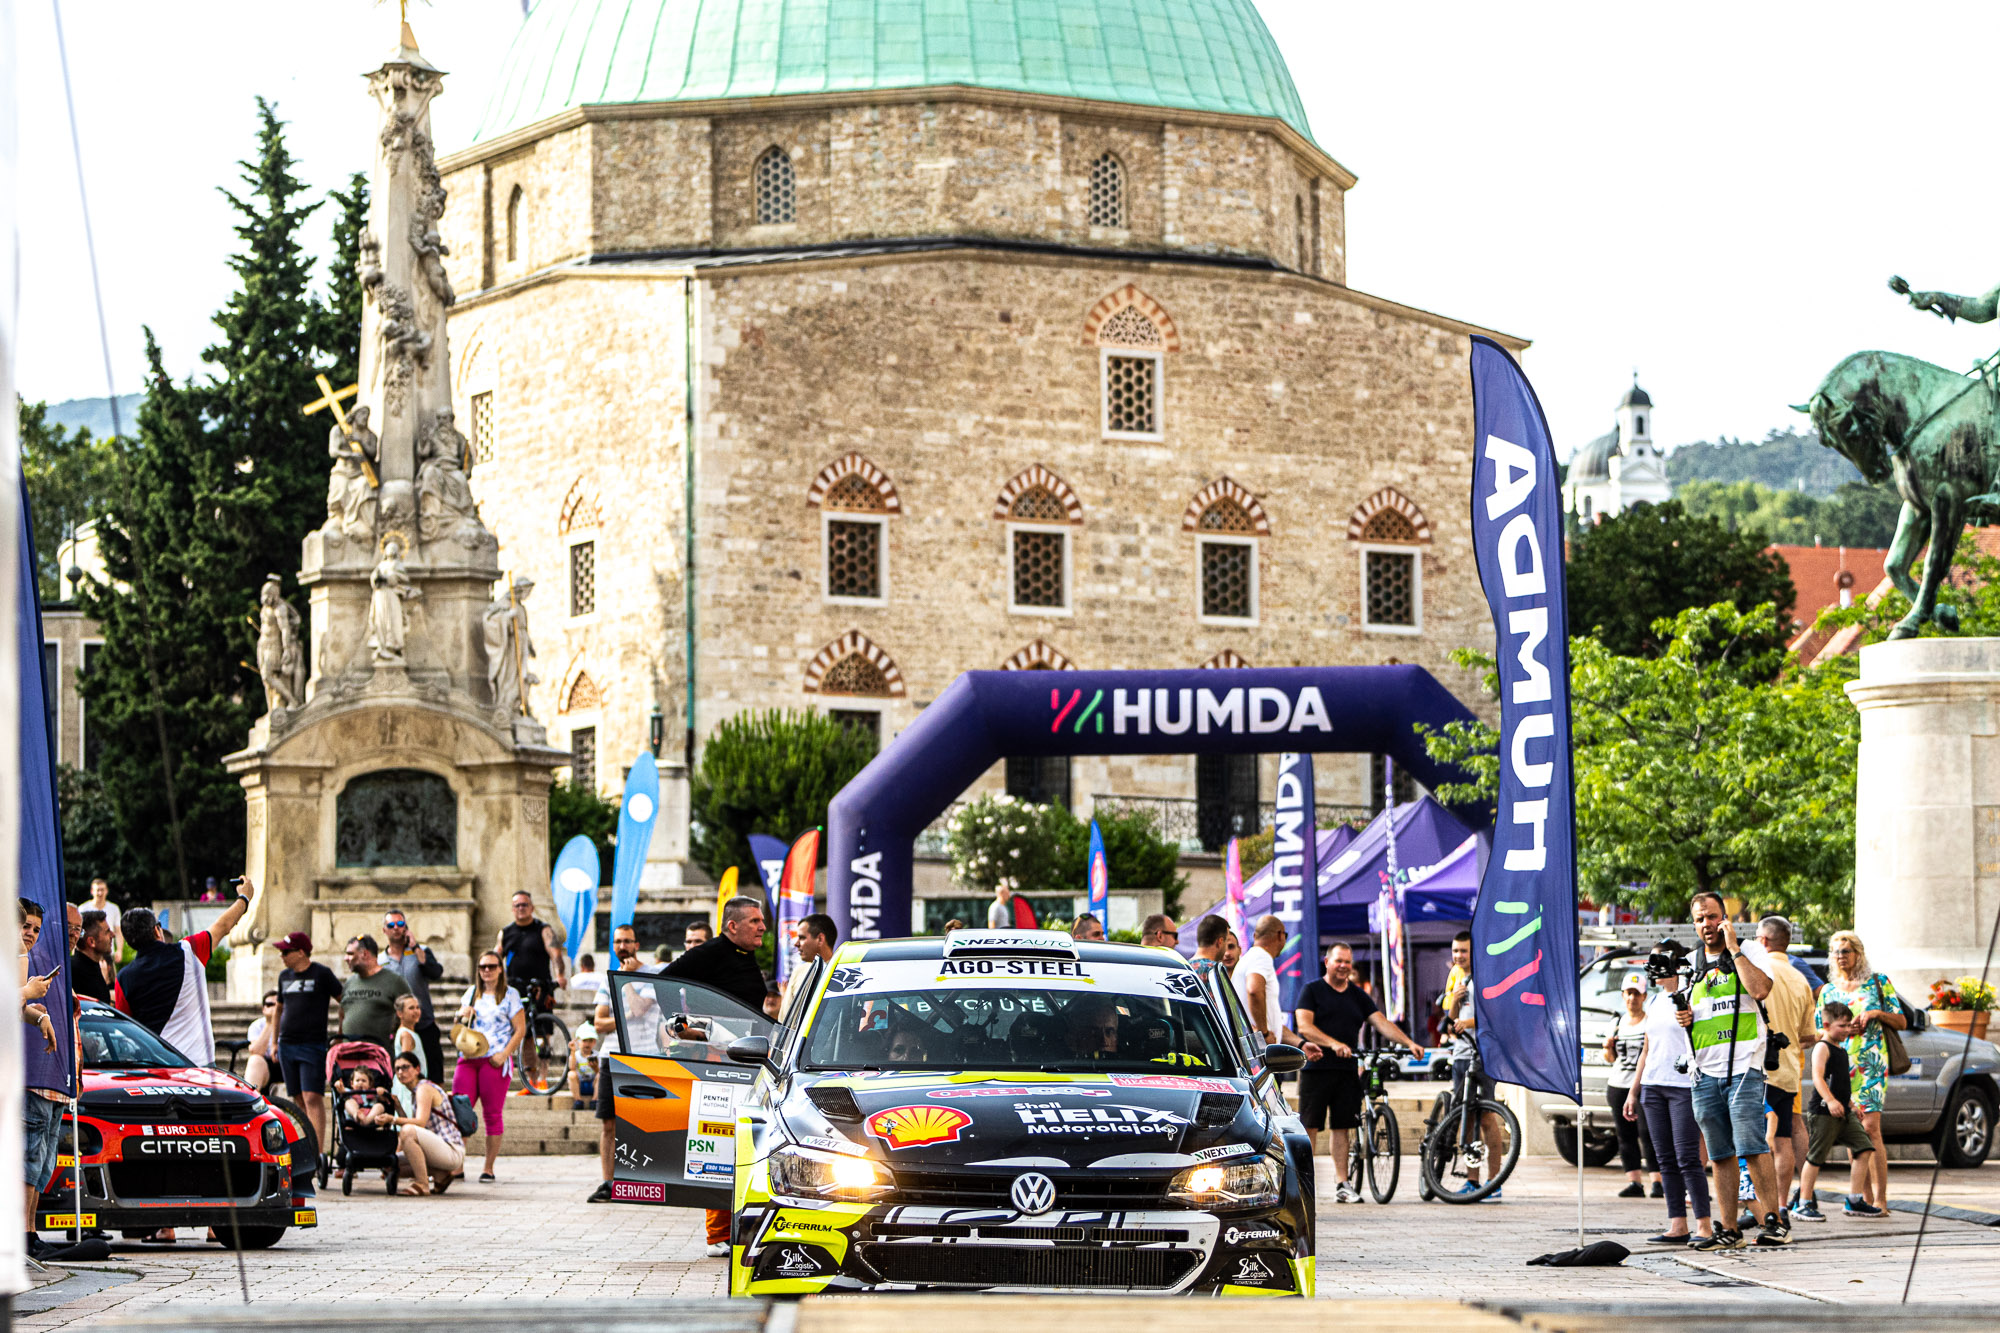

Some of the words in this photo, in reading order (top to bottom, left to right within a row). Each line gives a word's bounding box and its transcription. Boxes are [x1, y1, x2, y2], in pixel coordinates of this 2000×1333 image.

[1113, 687, 1333, 734] HUMDA
[850, 852, 882, 939] MDA
[967, 938, 1072, 948] NEXTAUTO
[940, 961, 1091, 977] AGO-STEEL
[142, 1086, 212, 1096] ENEOS
[703, 1094, 729, 1103] PENTHE
[1013, 1102, 1061, 1110] Shell
[1014, 1107, 1191, 1124] HELIX
[702, 1123, 735, 1136] PIREL
[1028, 1123, 1176, 1135] Motorolajok
[141, 1138, 236, 1154] CITROËN
[688, 1139, 715, 1152] PSN
[1202, 1144, 1252, 1158] NEXTAUTO
[615, 1183, 662, 1199] SERVICES
[781, 1249, 803, 1266] Silk
[1239, 1258, 1259, 1275] Silk
